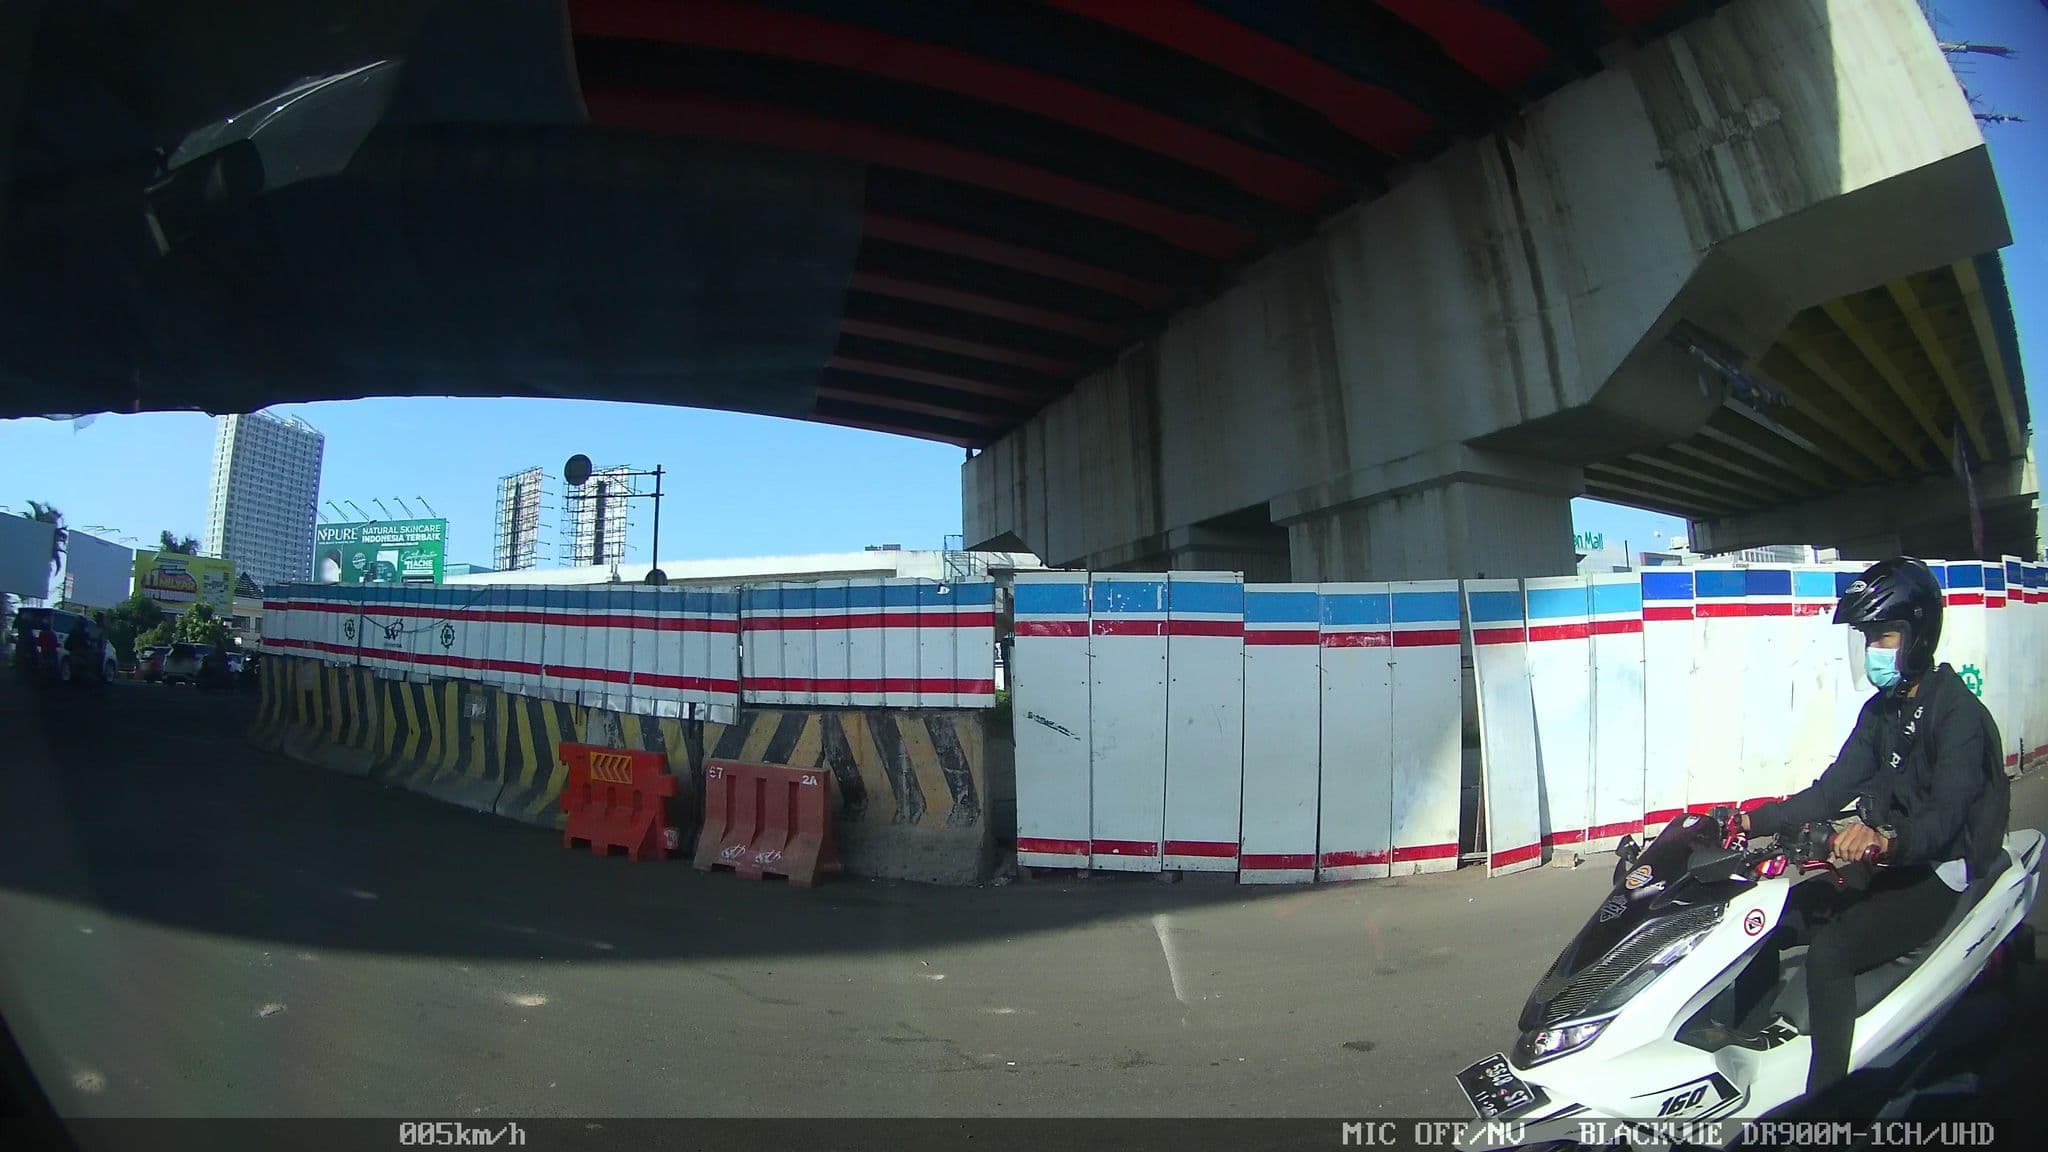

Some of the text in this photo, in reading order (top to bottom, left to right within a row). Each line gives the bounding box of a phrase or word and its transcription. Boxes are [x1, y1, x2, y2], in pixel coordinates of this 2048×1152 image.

[362, 524, 441, 535] NATURAL SKINCARE
[362, 533, 441, 543] INDONESIA TERBAIK
[1585, 531, 1604, 550] Mall
[802, 774, 818, 787] 2A
[1657, 1084, 1709, 1117] 160
